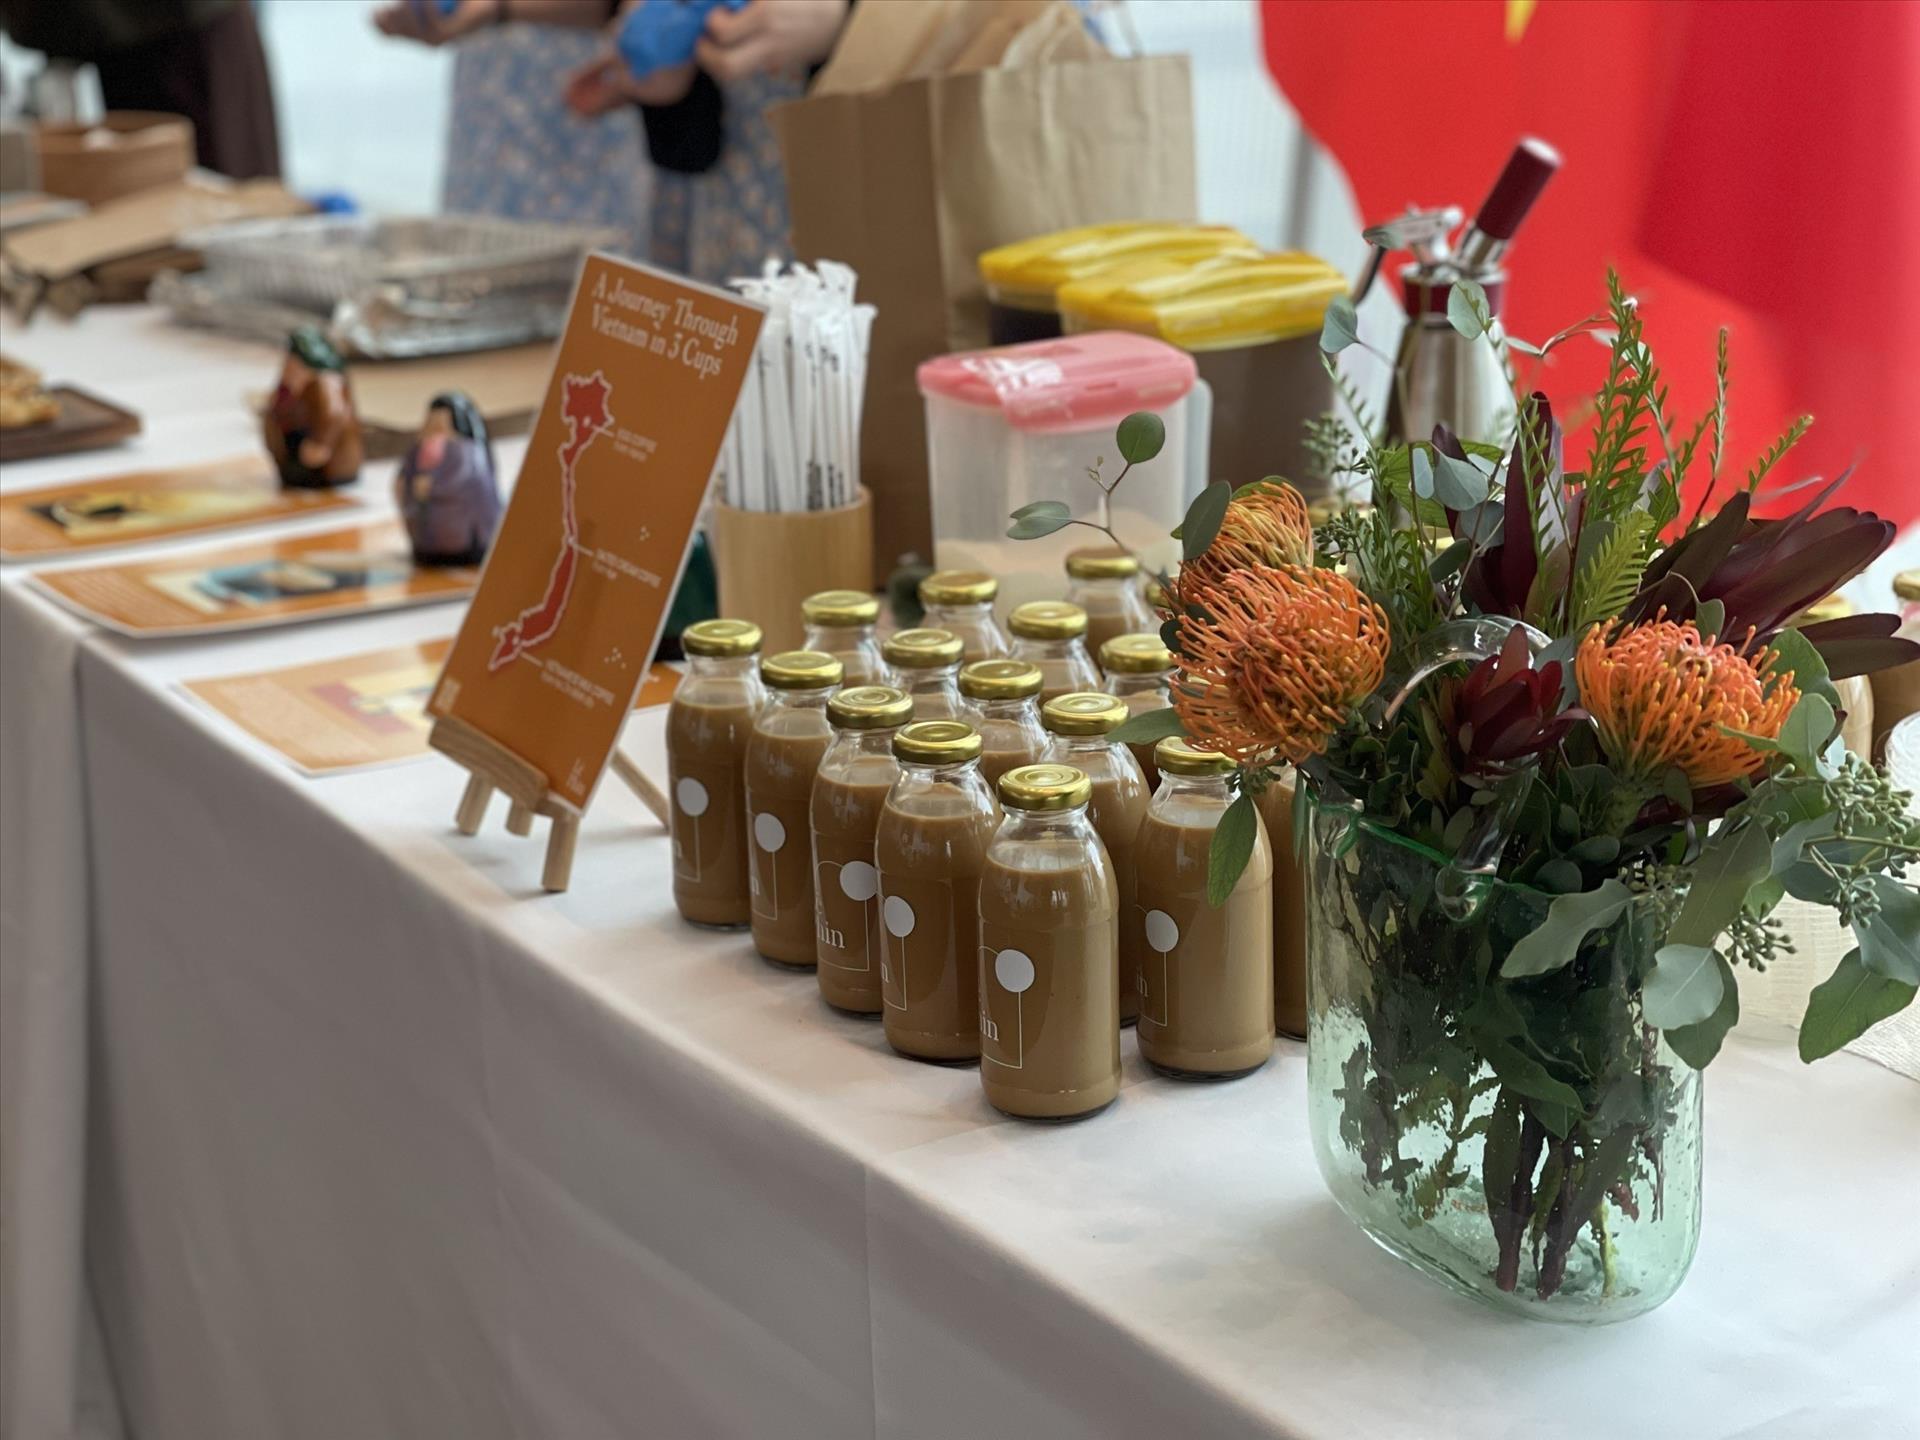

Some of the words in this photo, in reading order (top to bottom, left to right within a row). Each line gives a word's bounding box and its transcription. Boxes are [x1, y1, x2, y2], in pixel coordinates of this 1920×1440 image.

[591, 271, 607, 299] A
[607, 277, 670, 330] Journey
[674, 297, 739, 350] Through
[591, 303, 648, 350] Vietnam
[651, 333, 666, 357] in
[667, 333, 682, 360] 3
[682, 340, 722, 379] Cups
